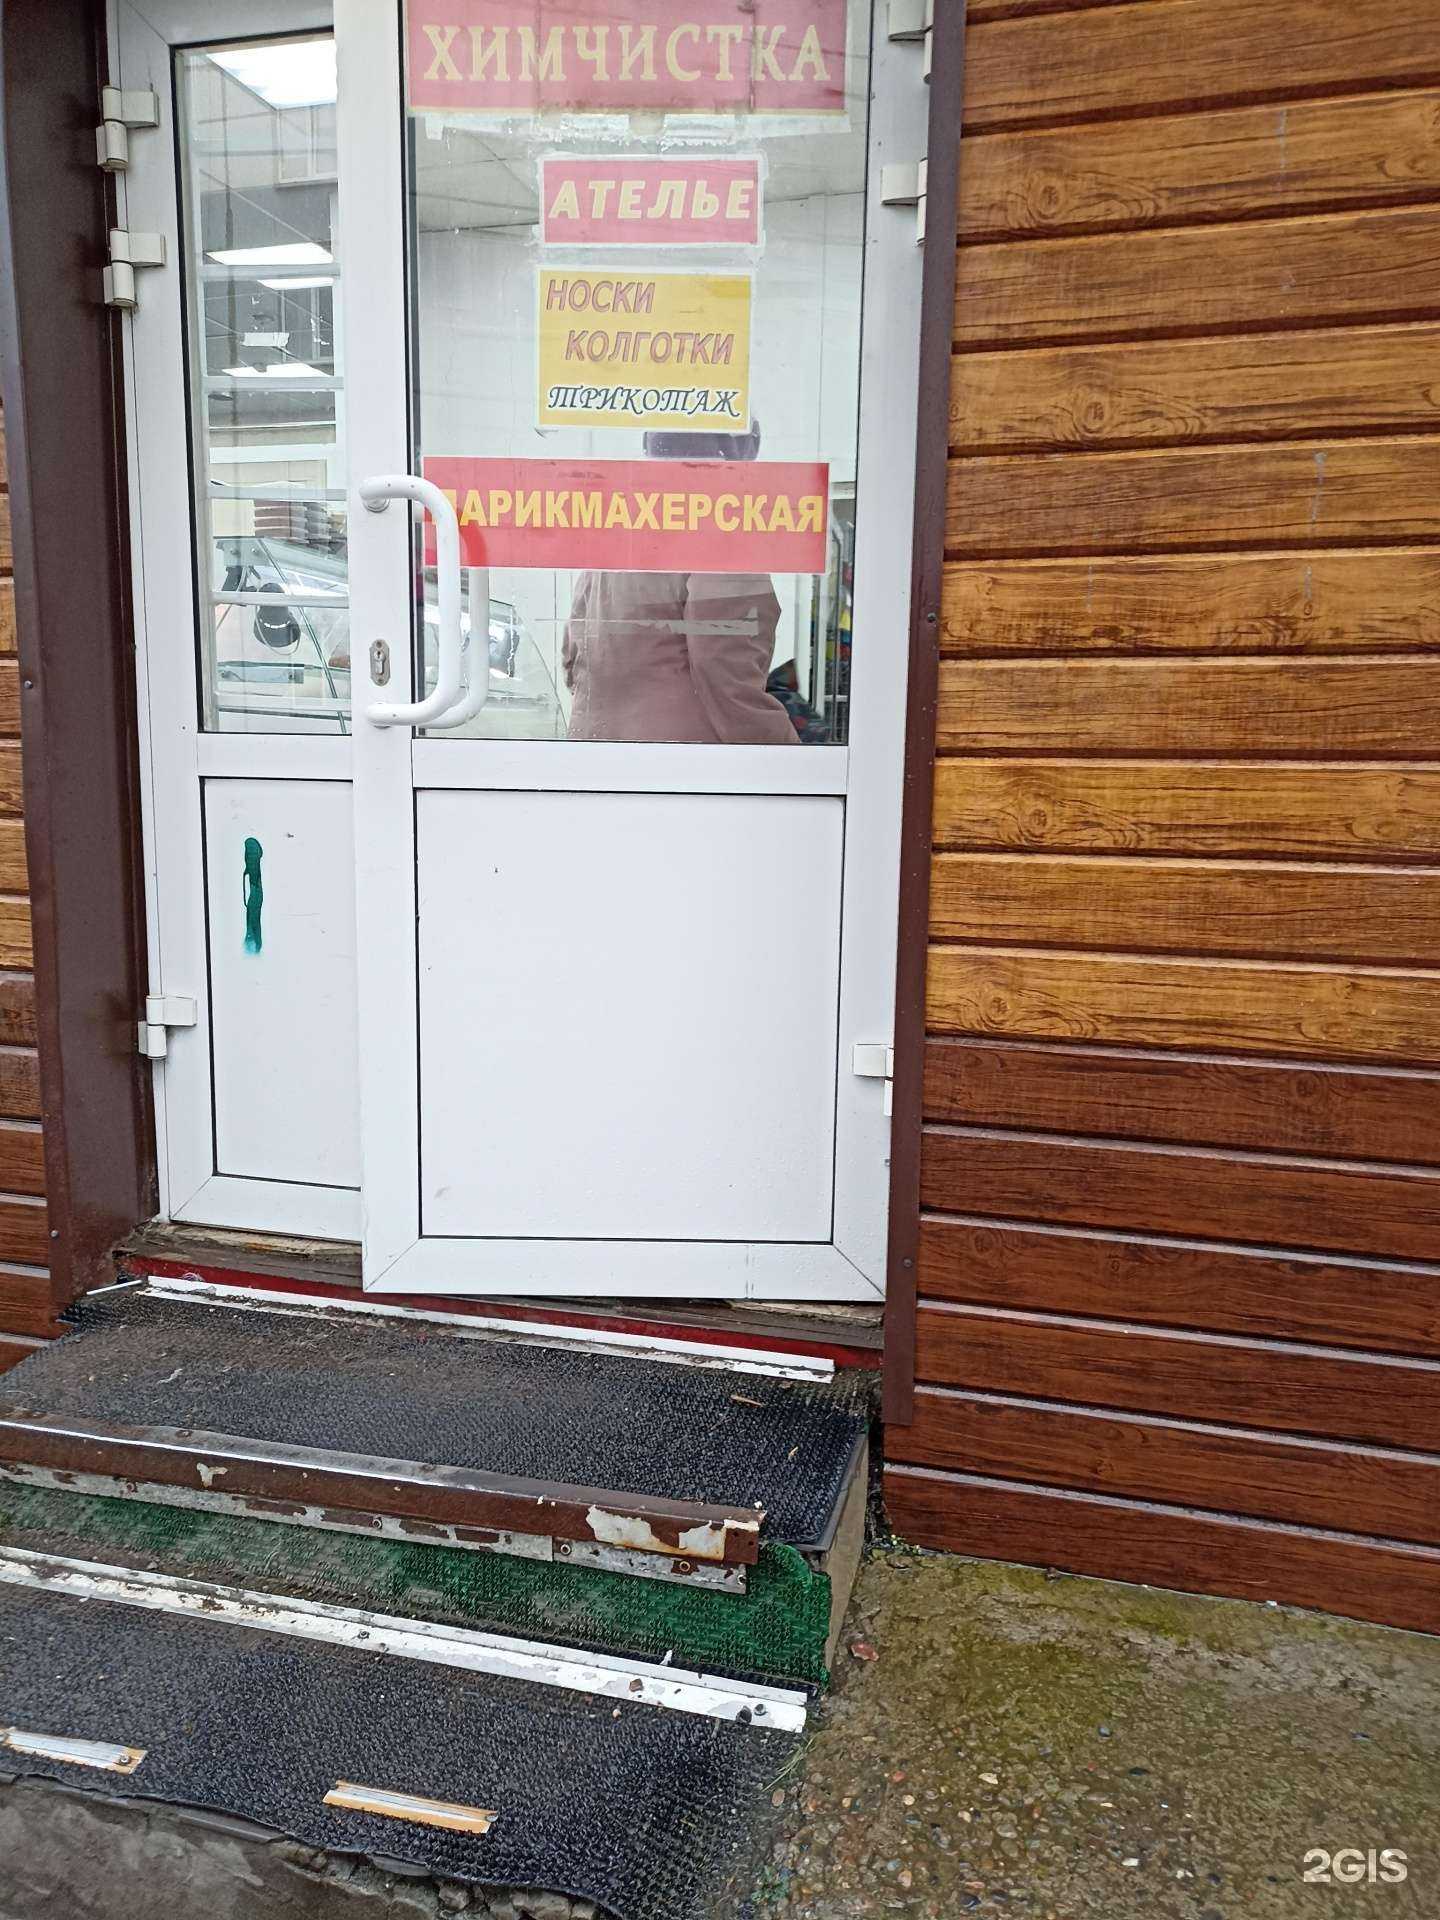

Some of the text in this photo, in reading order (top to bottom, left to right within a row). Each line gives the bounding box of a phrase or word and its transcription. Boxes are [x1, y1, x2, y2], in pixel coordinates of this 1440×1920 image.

[422, 24, 831, 82] ХИМЧИСТКА
[548, 180, 755, 219] АТЕЛЬЕ
[546, 279, 656, 314] НОСКИ
[565, 329, 735, 365] КОЛГОТКИ
[548, 385, 741, 417] ТРИКОТАЖ
